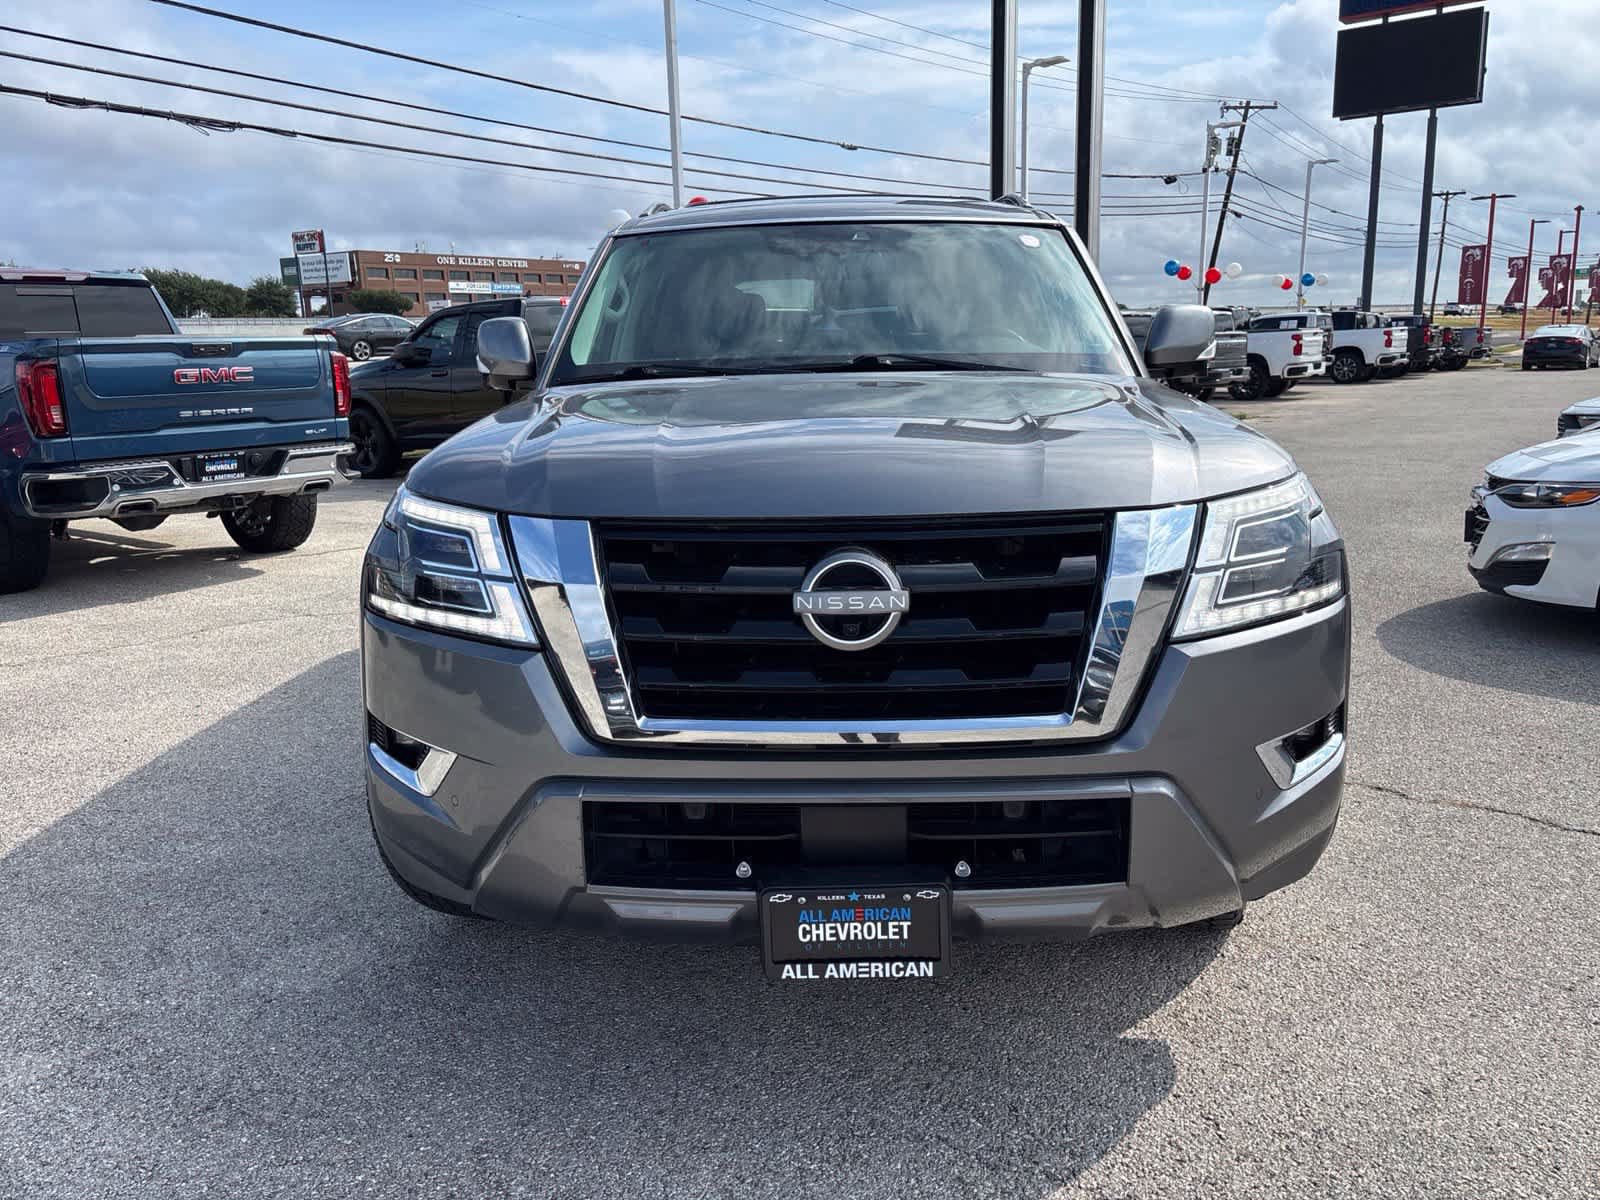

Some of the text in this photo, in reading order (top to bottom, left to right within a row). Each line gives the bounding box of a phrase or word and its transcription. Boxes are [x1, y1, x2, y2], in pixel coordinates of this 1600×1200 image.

[436, 256, 528, 268] ONE KILLEEN CENTER
[174, 367, 254, 384] GMC
[179, 407, 253, 417] SIERRA
[205, 463, 238, 471] CHEVROLET
[214, 472, 244, 480] AMERICAN
[796, 596, 906, 609] NISSAN
[799, 907, 911, 923] ALL AMERICAN
[799, 921, 911, 942] CHEVROLET
[837, 942, 906, 950] KILLEEN
[781, 961, 934, 979] ALL AMERICAN
